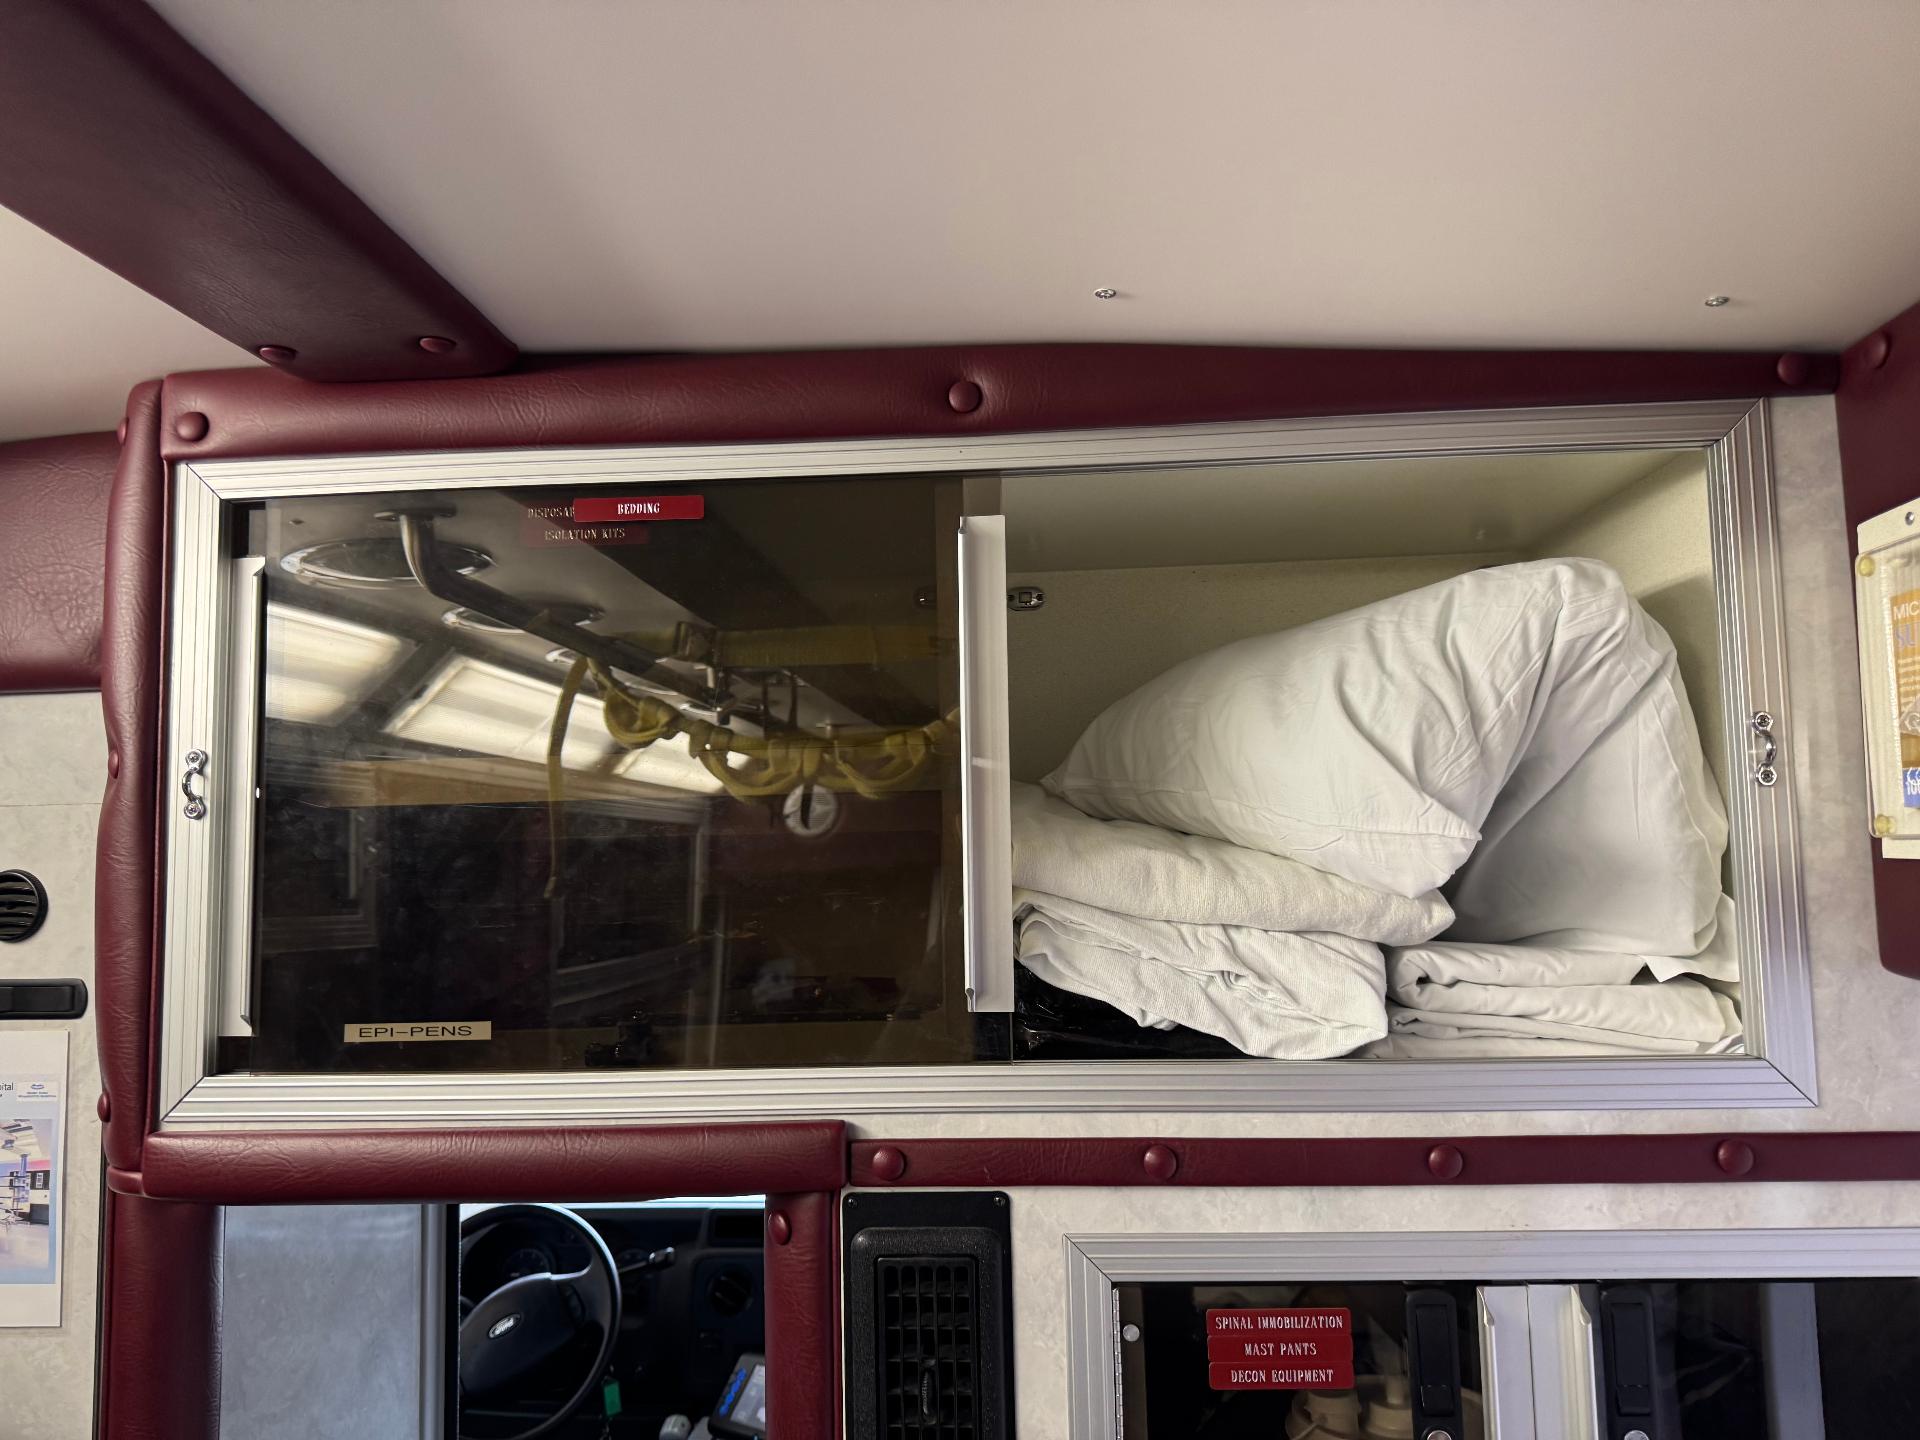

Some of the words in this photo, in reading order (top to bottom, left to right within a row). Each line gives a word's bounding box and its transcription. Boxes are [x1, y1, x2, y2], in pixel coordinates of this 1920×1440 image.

[617, 502, 660, 515] BEDDING
[544, 529, 597, 540] ISOLATION
[602, 528, 625, 539] KITS
[359, 1026, 472, 1038] EPI-PENS
[0, 1082, 14, 1091] ital
[1215, 1316, 1253, 1329] SPINAL
[1258, 1315, 1343, 1329] IMMOBILIZATION
[1244, 1343, 1275, 1356] MAST
[1280, 1342, 1317, 1356] PANTS
[1231, 1370, 1266, 1383] DECON
[1271, 1369, 1334, 1383] EQUIPMENT
